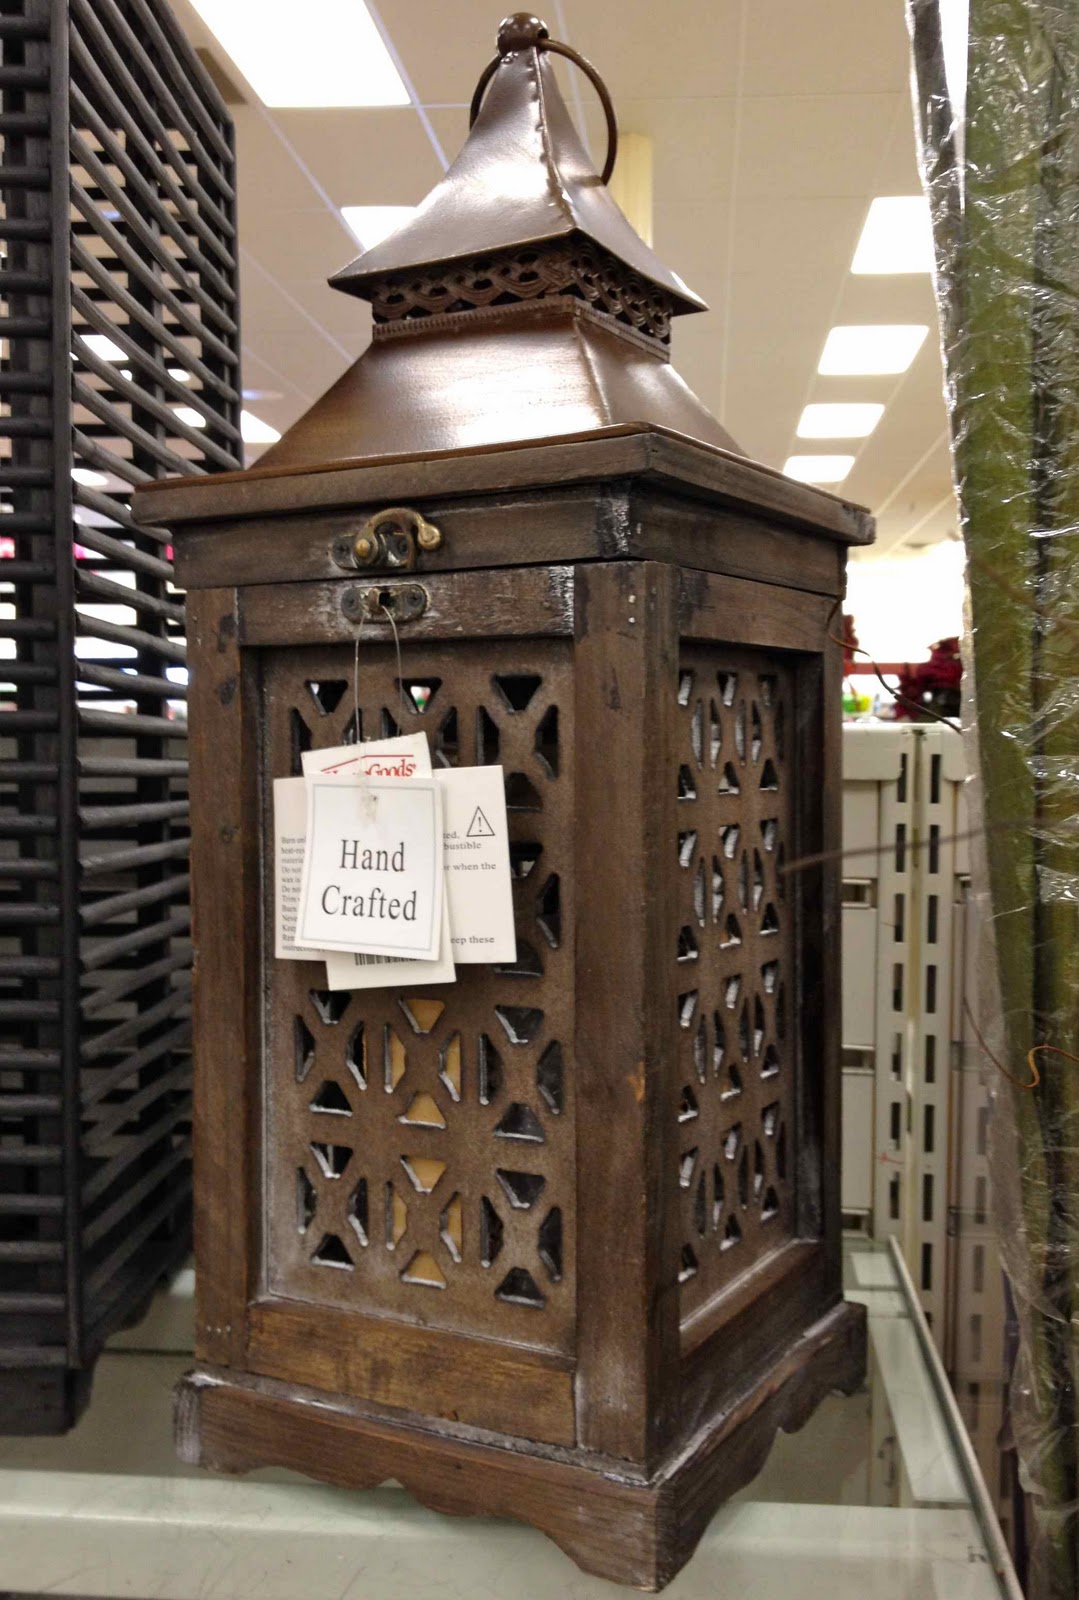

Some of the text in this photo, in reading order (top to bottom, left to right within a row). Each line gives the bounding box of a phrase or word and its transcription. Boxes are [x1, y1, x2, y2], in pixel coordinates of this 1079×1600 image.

[443, 842, 482, 850] bustible
[281, 856, 304, 864] materia
[339, 839, 406, 872] Hand
[453, 863, 479, 871] when
[481, 862, 496, 870] the
[321, 885, 417, 921] Crafted
[281, 914, 298, 922] Neve
[450, 935, 496, 945] eep these
